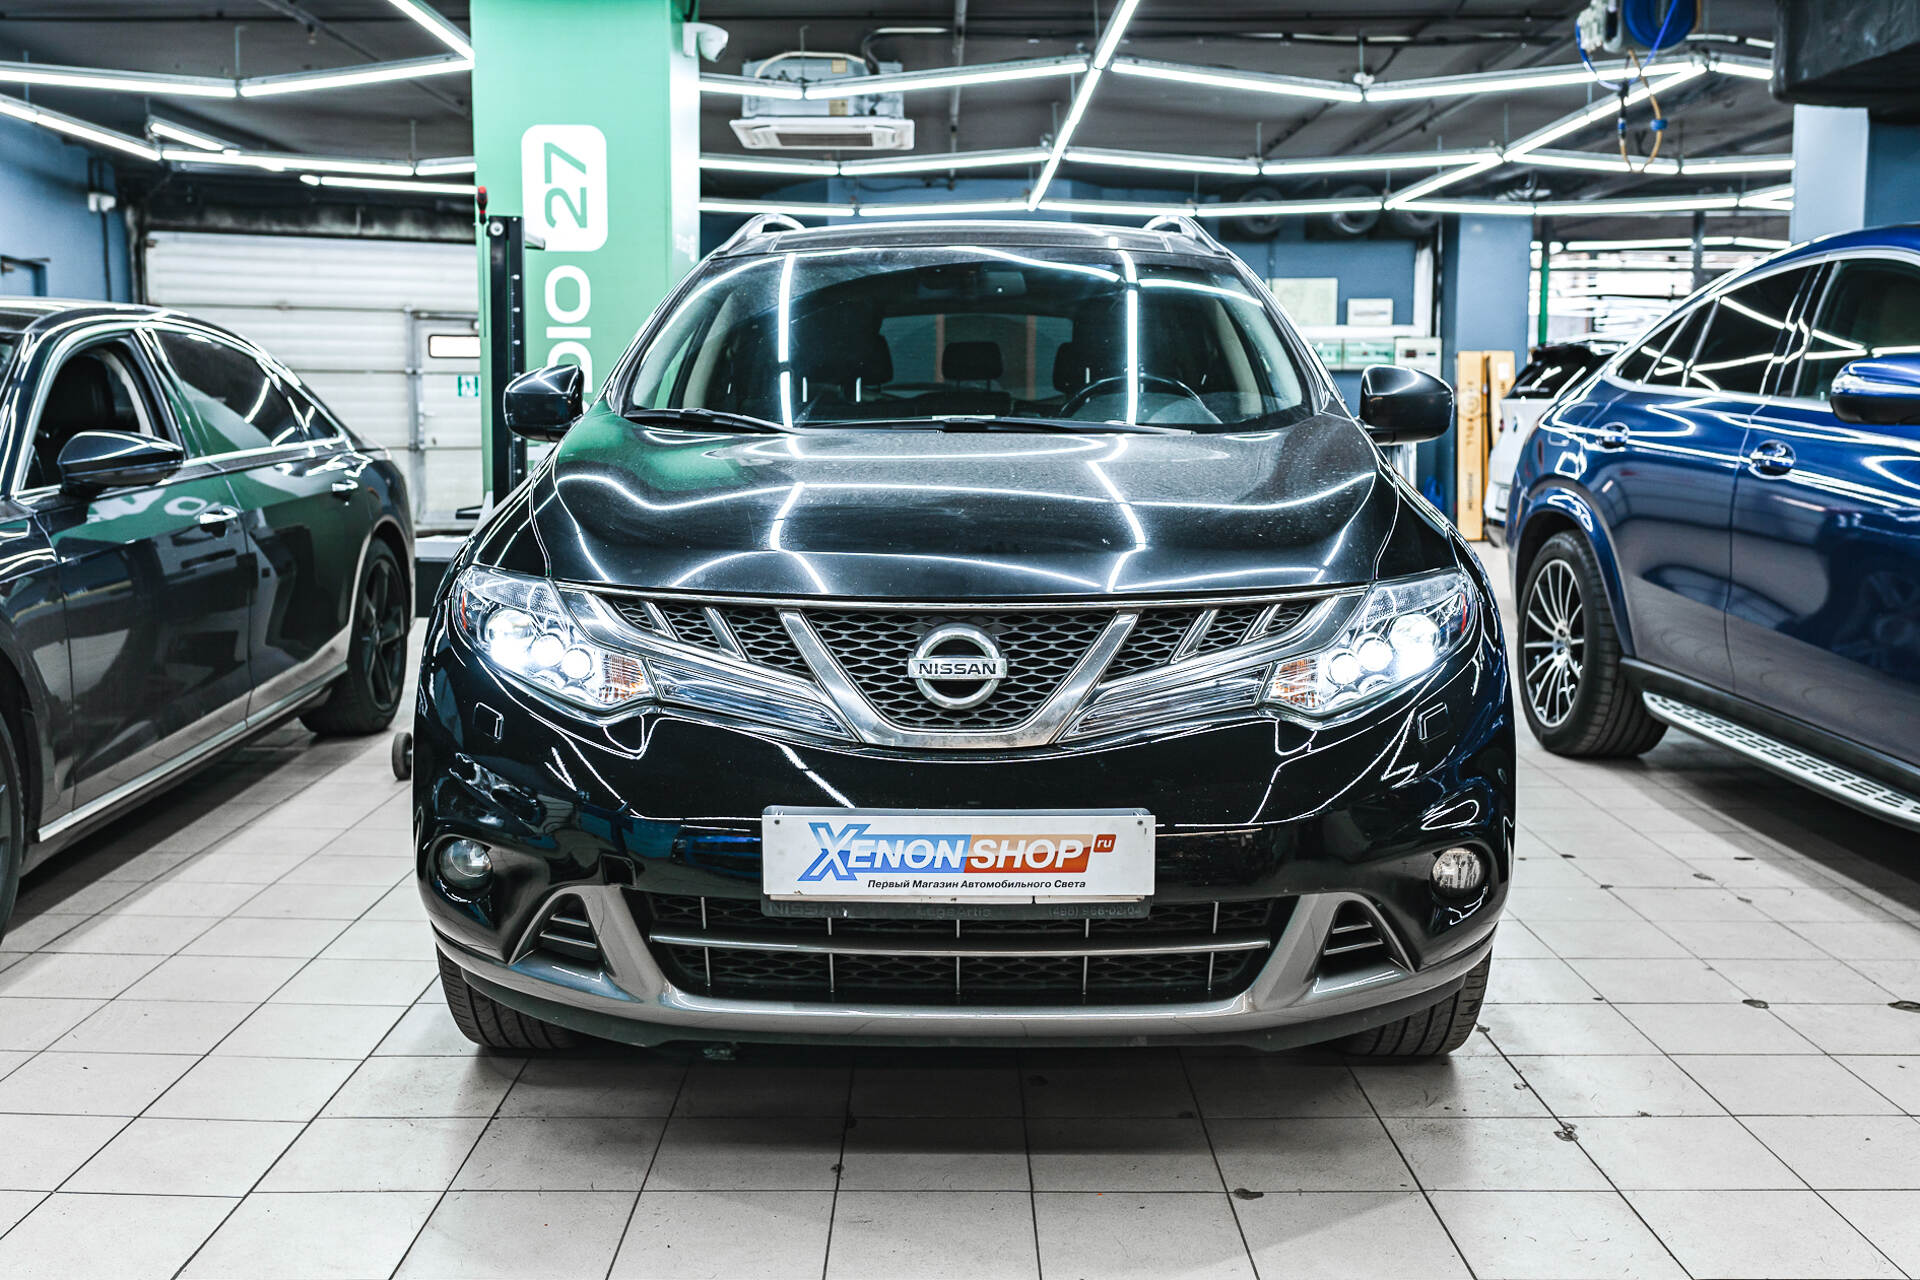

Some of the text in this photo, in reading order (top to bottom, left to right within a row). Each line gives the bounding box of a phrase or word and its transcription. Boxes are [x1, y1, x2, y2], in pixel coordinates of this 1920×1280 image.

[543, 142, 593, 395] DIO 27
[918, 663, 997, 675] NISSAN
[867, 879, 1086, 889] Первый Магазин Автомобильного Света
